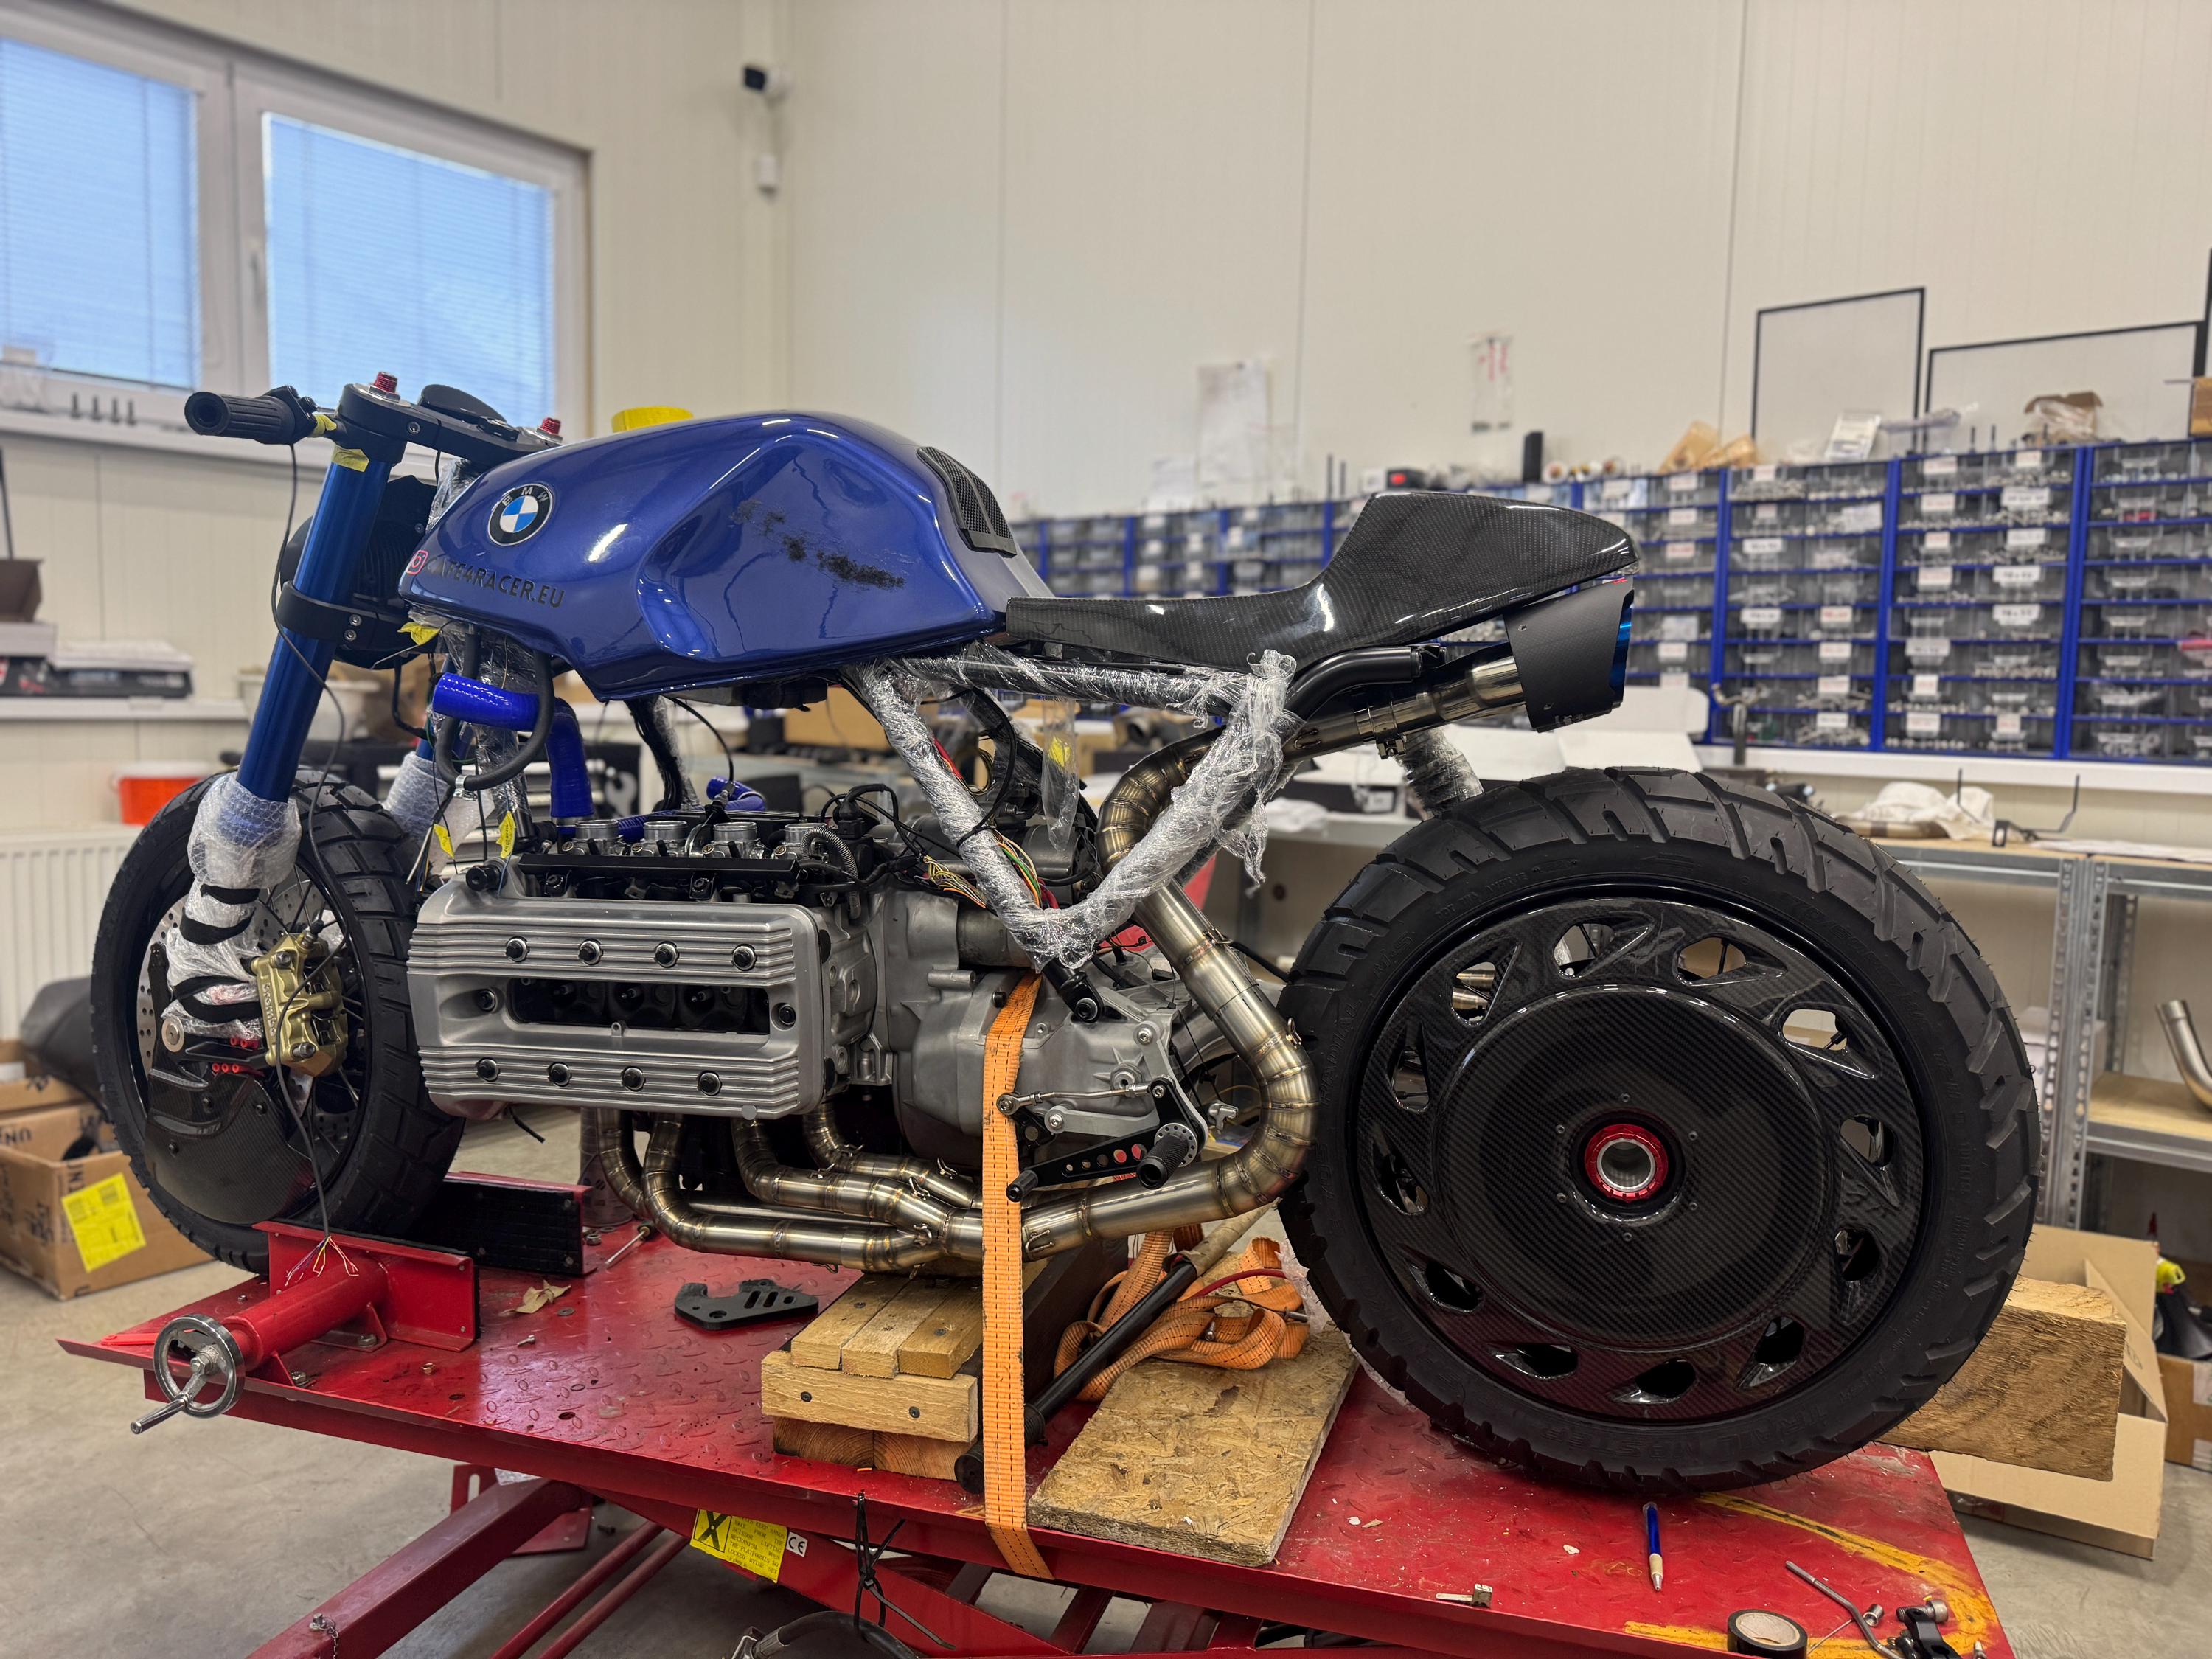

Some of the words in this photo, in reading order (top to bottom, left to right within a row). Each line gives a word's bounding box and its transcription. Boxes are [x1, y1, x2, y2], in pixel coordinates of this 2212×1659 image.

[502, 487, 549, 506] BMW
[262, 983, 276, 1037] brembo
[788, 1537, 806, 1554] CE
